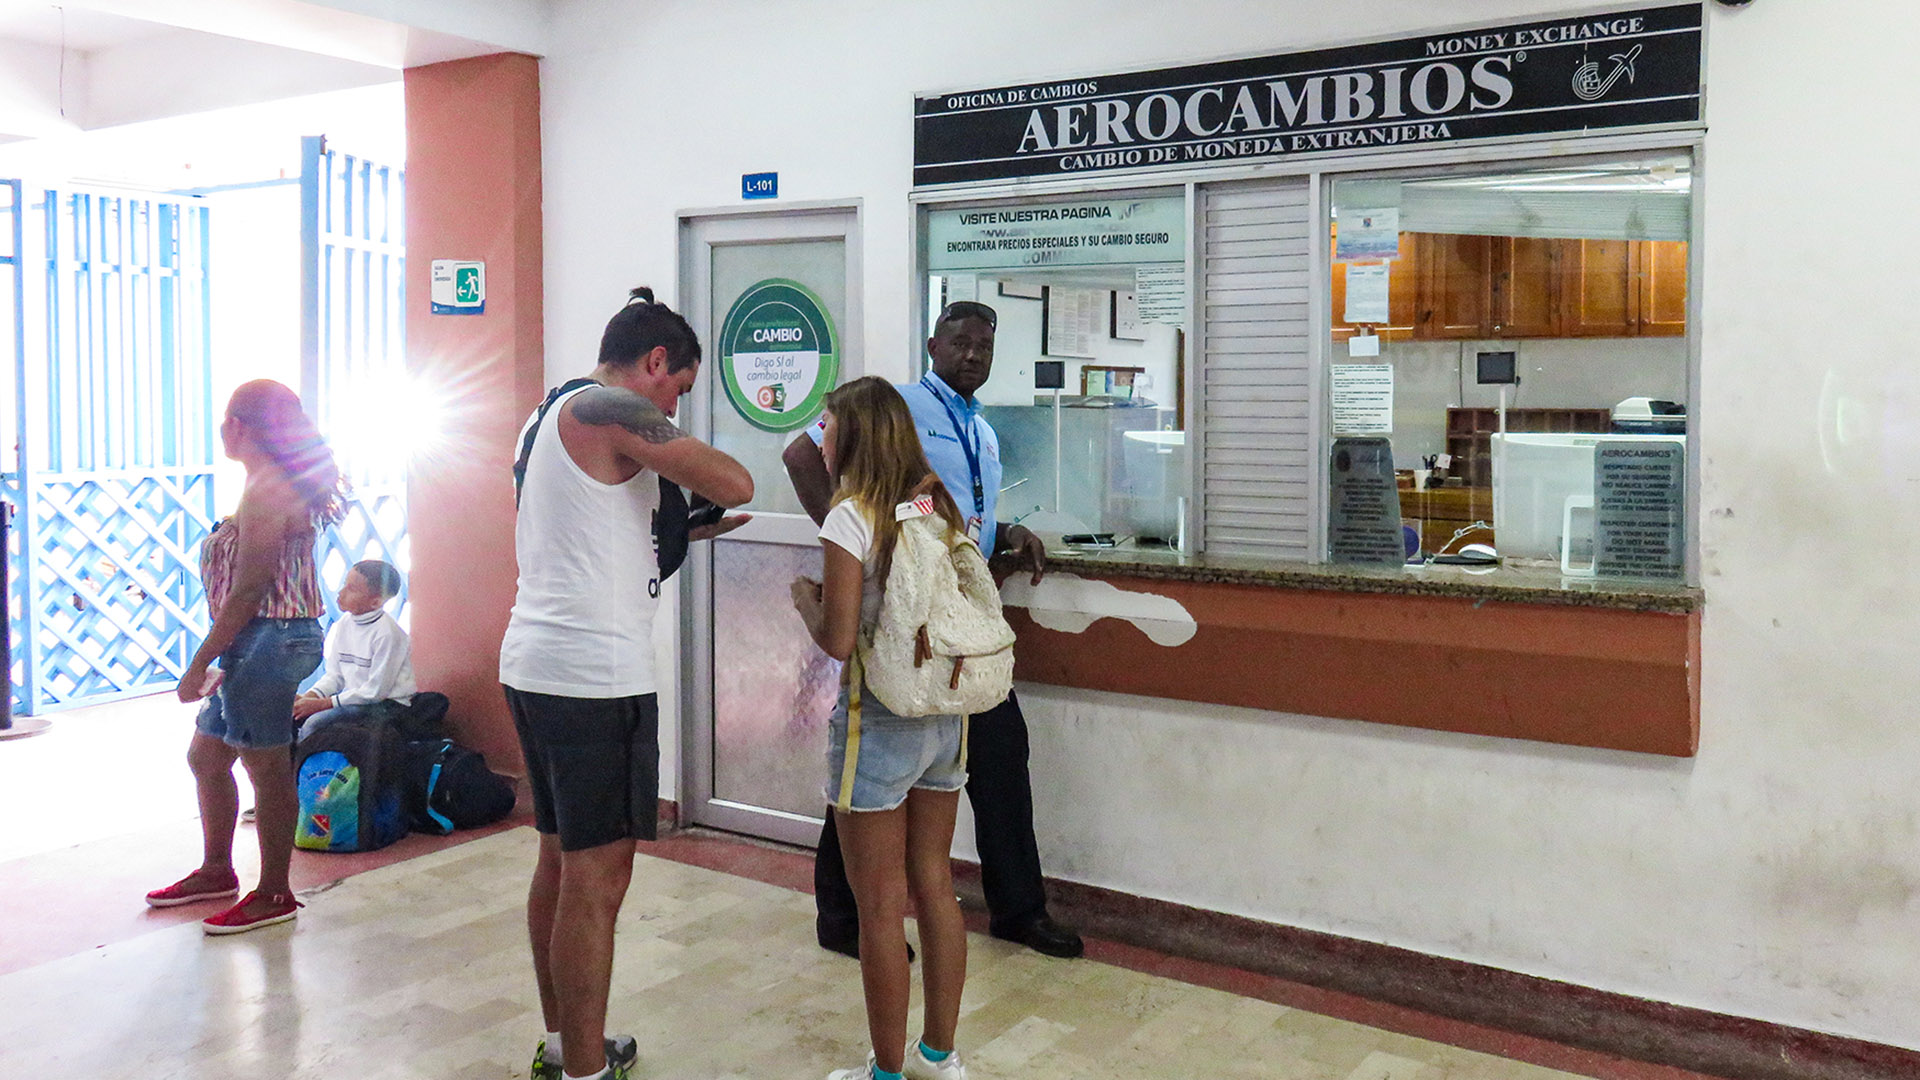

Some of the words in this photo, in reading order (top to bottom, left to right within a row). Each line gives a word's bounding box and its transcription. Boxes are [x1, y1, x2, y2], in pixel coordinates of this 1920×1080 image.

[1426, 34, 1507, 56] MONEY
[1515, 17, 1644, 46] EXCHANGE
[947, 91, 1004, 110] OFICINA
[1008, 89, 1027, 103] DE
[1031, 82, 1098, 101] CAMBIOS
[1059, 149, 1142, 171] CAMBIO
[1148, 147, 1177, 163] DE
[1184, 138, 1286, 160] MONEDA
[1291, 123, 1452, 150] EXTRANJERA
[746, 179, 773, 192] L-101
[959, 212, 997, 226] VISITE
[999, 207, 1059, 224] NUESTRA
[1060, 206, 1112, 220] PAGINA
[947, 238, 997, 253] ENCONTRARA
[998, 237, 1031, 250] PRECIOS
[1032, 236, 1079, 249] ESPECIALES
[1081, 236, 1087, 247] Y
[1088, 235, 1100, 247] SU
[1101, 233, 1133, 246] CAMBIO
[1135, 232, 1169, 245] SEGURO
[753, 327, 803, 343] CAMBIO
[754, 357, 775, 370] Digo
[746, 370, 779, 382] cambio
[780, 369, 803, 384] legal
